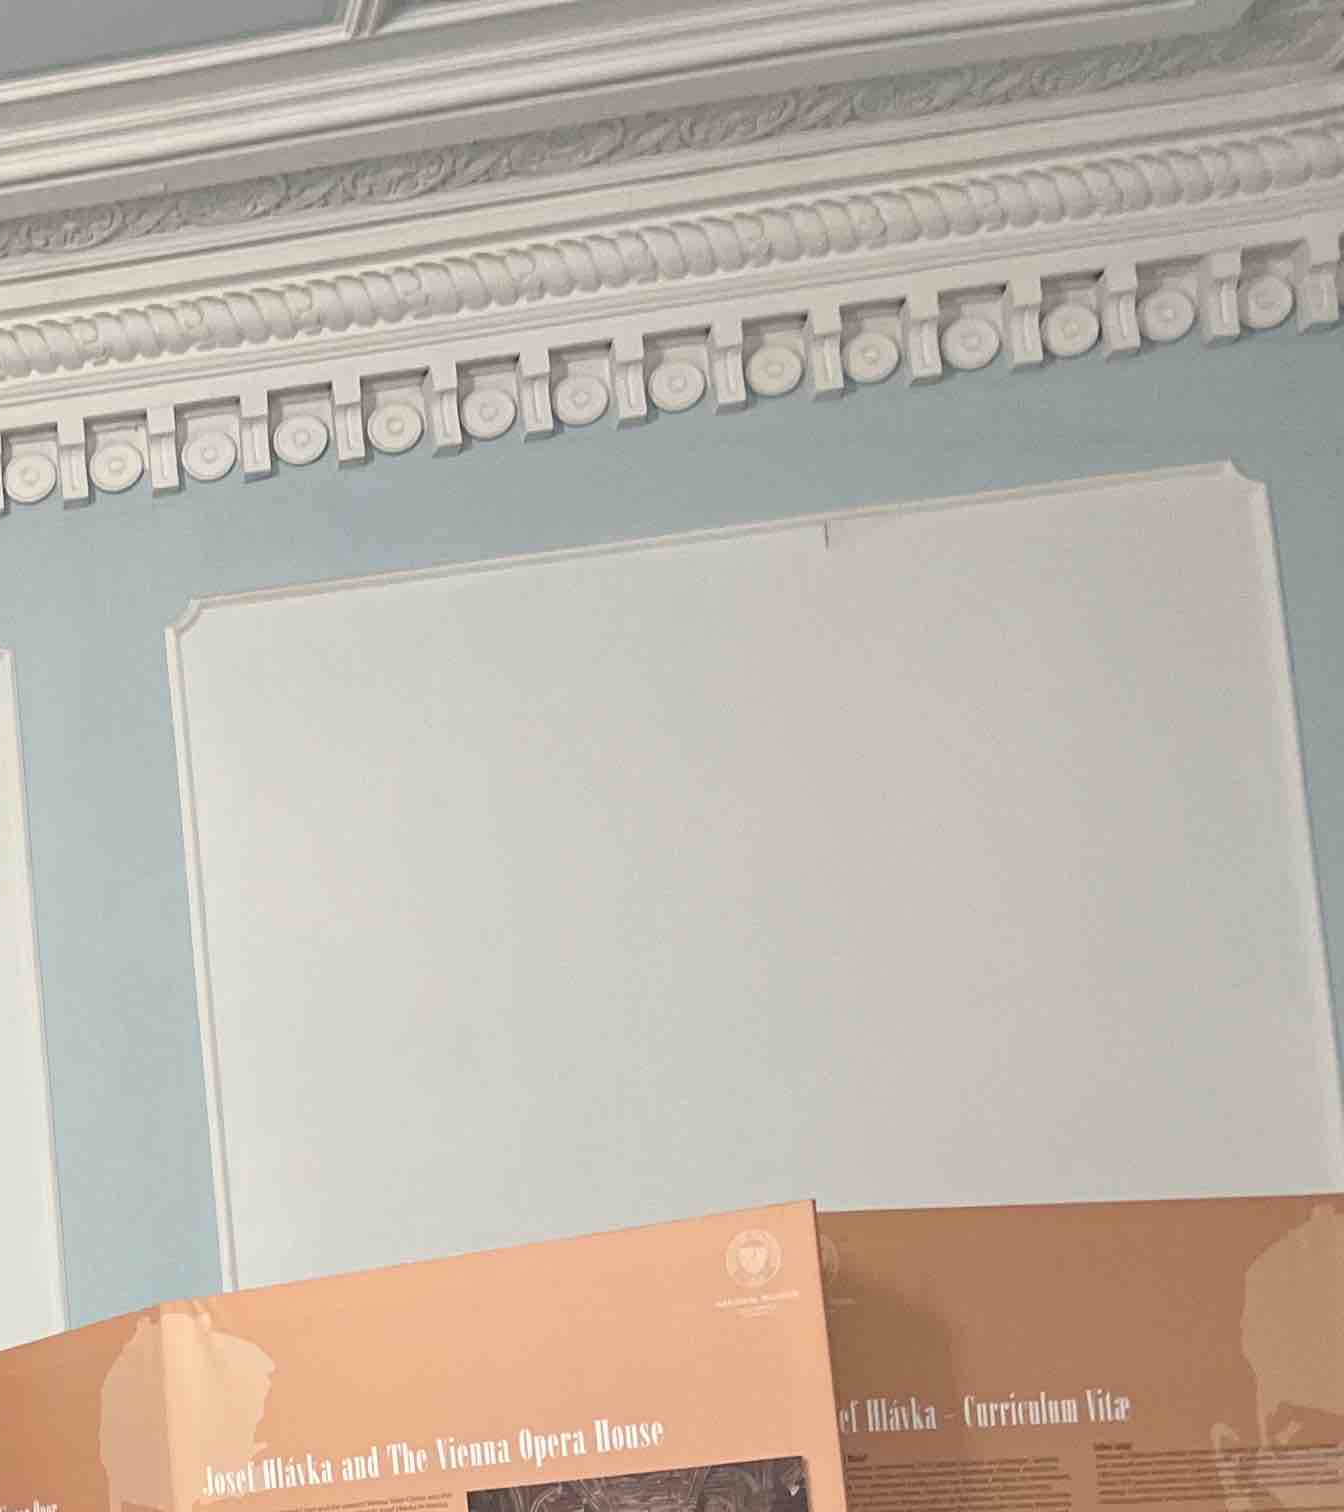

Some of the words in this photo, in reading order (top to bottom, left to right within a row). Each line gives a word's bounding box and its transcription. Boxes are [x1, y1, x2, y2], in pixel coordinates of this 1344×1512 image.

[866, 1397, 937, 1432] Hlávka
[963, 1391, 1079, 1428] Curriculum
[1085, 1388, 1131, 1423] Vitæ
[202, 1461, 256, 1497] Josef
[263, 1453, 333, 1490] Hlávka
[341, 1446, 380, 1481] and
[386, 1441, 428, 1475] The
[435, 1437, 511, 1470] Vienna
[518, 1428, 587, 1468] Opera
[592, 1419, 664, 1453] House
